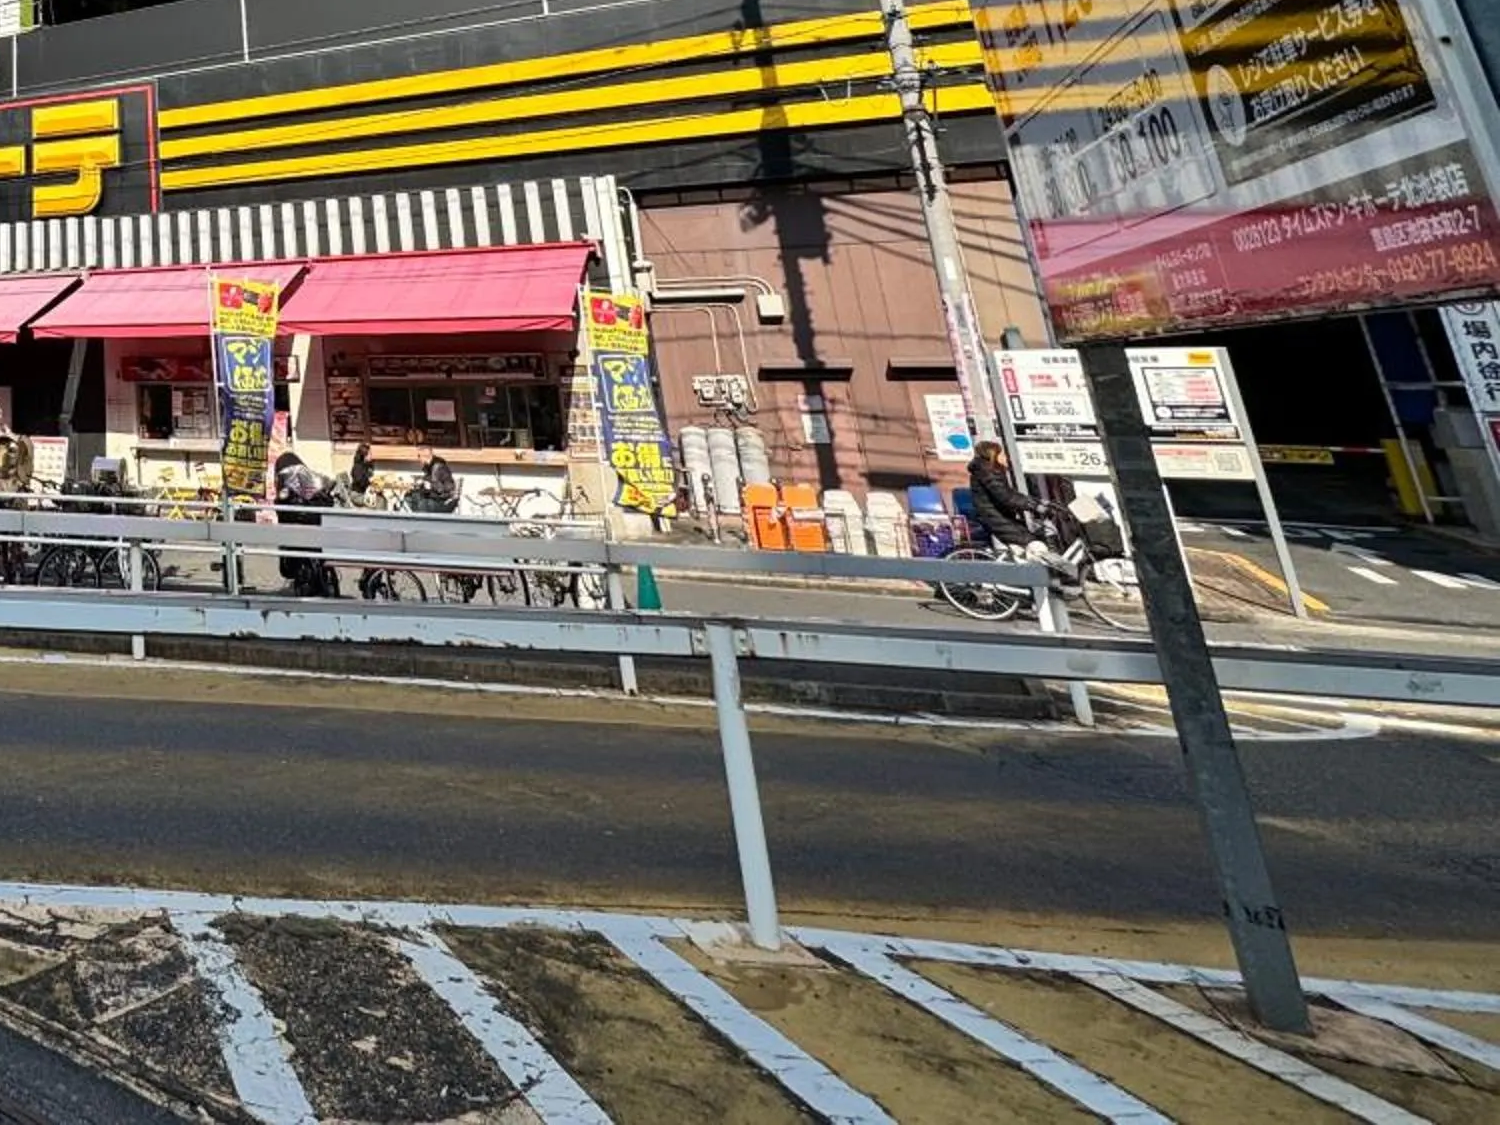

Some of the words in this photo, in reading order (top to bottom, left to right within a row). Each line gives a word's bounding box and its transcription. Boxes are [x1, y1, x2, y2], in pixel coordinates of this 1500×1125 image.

[1249, 44, 1368, 122] お受け取りください
